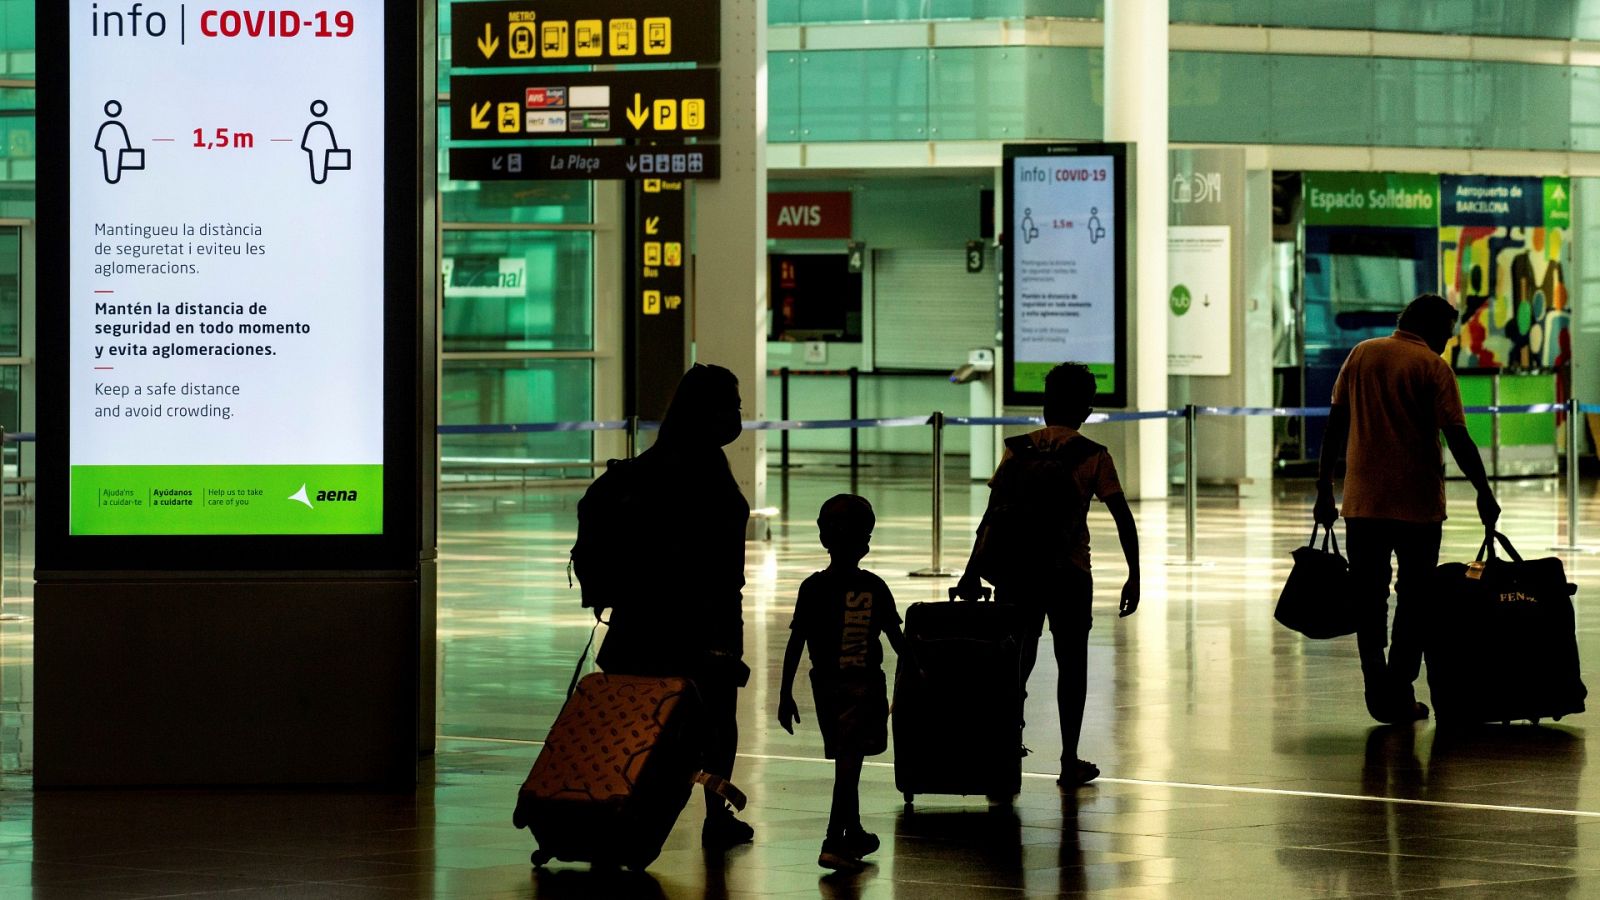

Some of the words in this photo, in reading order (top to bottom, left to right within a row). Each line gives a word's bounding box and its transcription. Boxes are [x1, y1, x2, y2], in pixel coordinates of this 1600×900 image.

[92, 3, 167, 37] info
[200, 10, 354, 38] COVID-19
[508, 11, 535, 21] METRO
[611, 22, 634, 30] HOTEL
[659, 105, 671, 124] P
[193, 128, 229, 149] 1,5
[233, 133, 254, 148] m
[550, 155, 564, 170] La
[567, 154, 600, 173] Plaça
[1020, 166, 1046, 182] info
[1056, 168, 1107, 182] COVID-19
[1311, 188, 1364, 212] Espacio
[1369, 188, 1433, 210] Solidario
[1456, 185, 1507, 199] Aeropuerto
[1510, 186, 1522, 197] de
[1456, 200, 1510, 213] BARCELONA
[777, 205, 822, 227] AVIS
[94, 223, 178, 239] Mantingueu
[183, 223, 195, 236] la
[199, 223, 262, 236] distància
[94, 242, 111, 255] de
[117, 243, 184, 259] seguretat
[197, 242, 241, 255] eviteu
[246, 242, 266, 255] les
[851, 252, 861, 268] 4
[970, 253, 981, 268] 3
[94, 261, 200, 277] aglomeracions.
[95, 302, 152, 315] Mantén
[157, 302, 170, 315] la
[175, 302, 244, 315] distancia
[249, 302, 267, 315] de
[664, 295, 682, 309] VIP
[95, 321, 171, 337] seguridad
[175, 324, 194, 334] en
[199, 321, 234, 334] todo
[239, 322, 311, 334] momento
[95, 346, 104, 359] y
[108, 343, 148, 356] evita
[152, 343, 277, 359] aglomeraciones.
[95, 383, 130, 399] Keep
[134, 386, 142, 396] a
[147, 382, 176, 396] safe
[181, 383, 240, 396] distance
[95, 404, 121, 418] and
[125, 404, 162, 418] avoid
[167, 404, 234, 420] crowding.
[103, 488, 134, 498] Ajuda'ns
[153, 488, 193, 498] Ayúdanos
[208, 488, 224, 498] Help
[247, 488, 264, 496] take
[316, 490, 358, 502] aena
[160, 498, 193, 506] cuidarte
[226, 498, 233, 506] of
[234, 499, 250, 508] you
